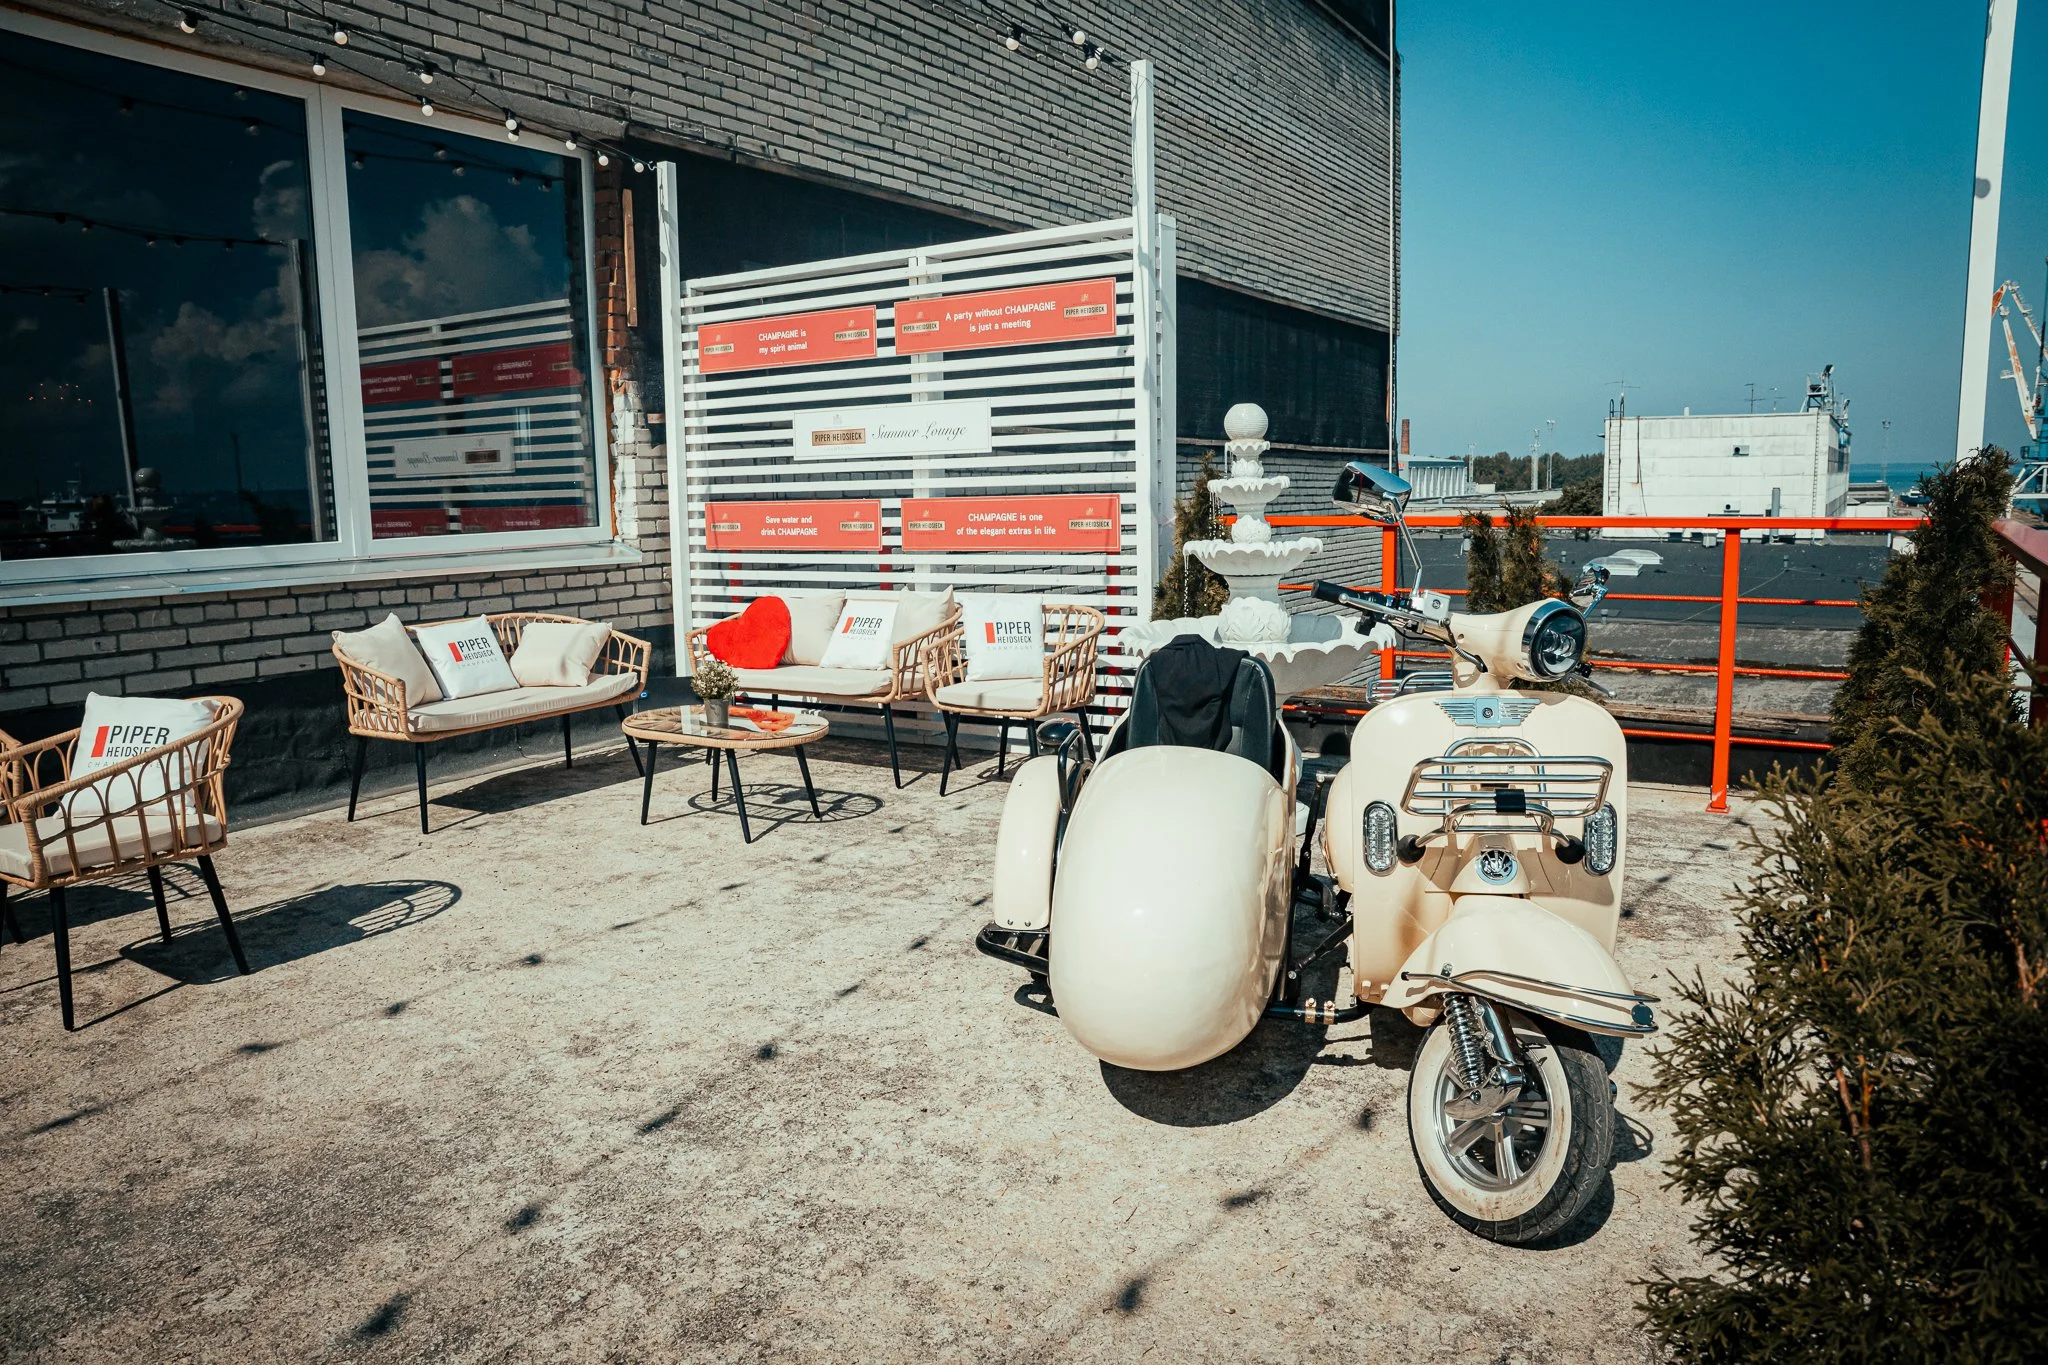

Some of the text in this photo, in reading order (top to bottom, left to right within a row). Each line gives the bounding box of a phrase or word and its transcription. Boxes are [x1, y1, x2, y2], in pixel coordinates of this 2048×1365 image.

[945, 301, 1056, 323] A party without CHAMPAGNE
[969, 324, 976, 333] is
[978, 322, 992, 334] just
[1001, 318, 1031, 331] meeting
[758, 329, 807, 342] CHAMPAGNE is
[759, 341, 808, 355] my spirit animal
[815, 431, 863, 442] PIPER HEIDSIECK
[872, 421, 968, 441] Summer Lounge
[765, 515, 813, 524] Save water and
[968, 513, 1043, 522] CHAMPAGNE is one
[761, 528, 818, 536] drink CHAMPAGNE
[956, 526, 1056, 537] of the elegant extras in life
[853, 616, 883, 629] PIPER
[996, 621, 1031, 635] PIPER
[457, 637, 491, 653] PIPER
[997, 635, 1032, 644] HEIDSIECK
[463, 649, 495, 661] HEIDSIECK
[109, 725, 170, 745] PIPER
